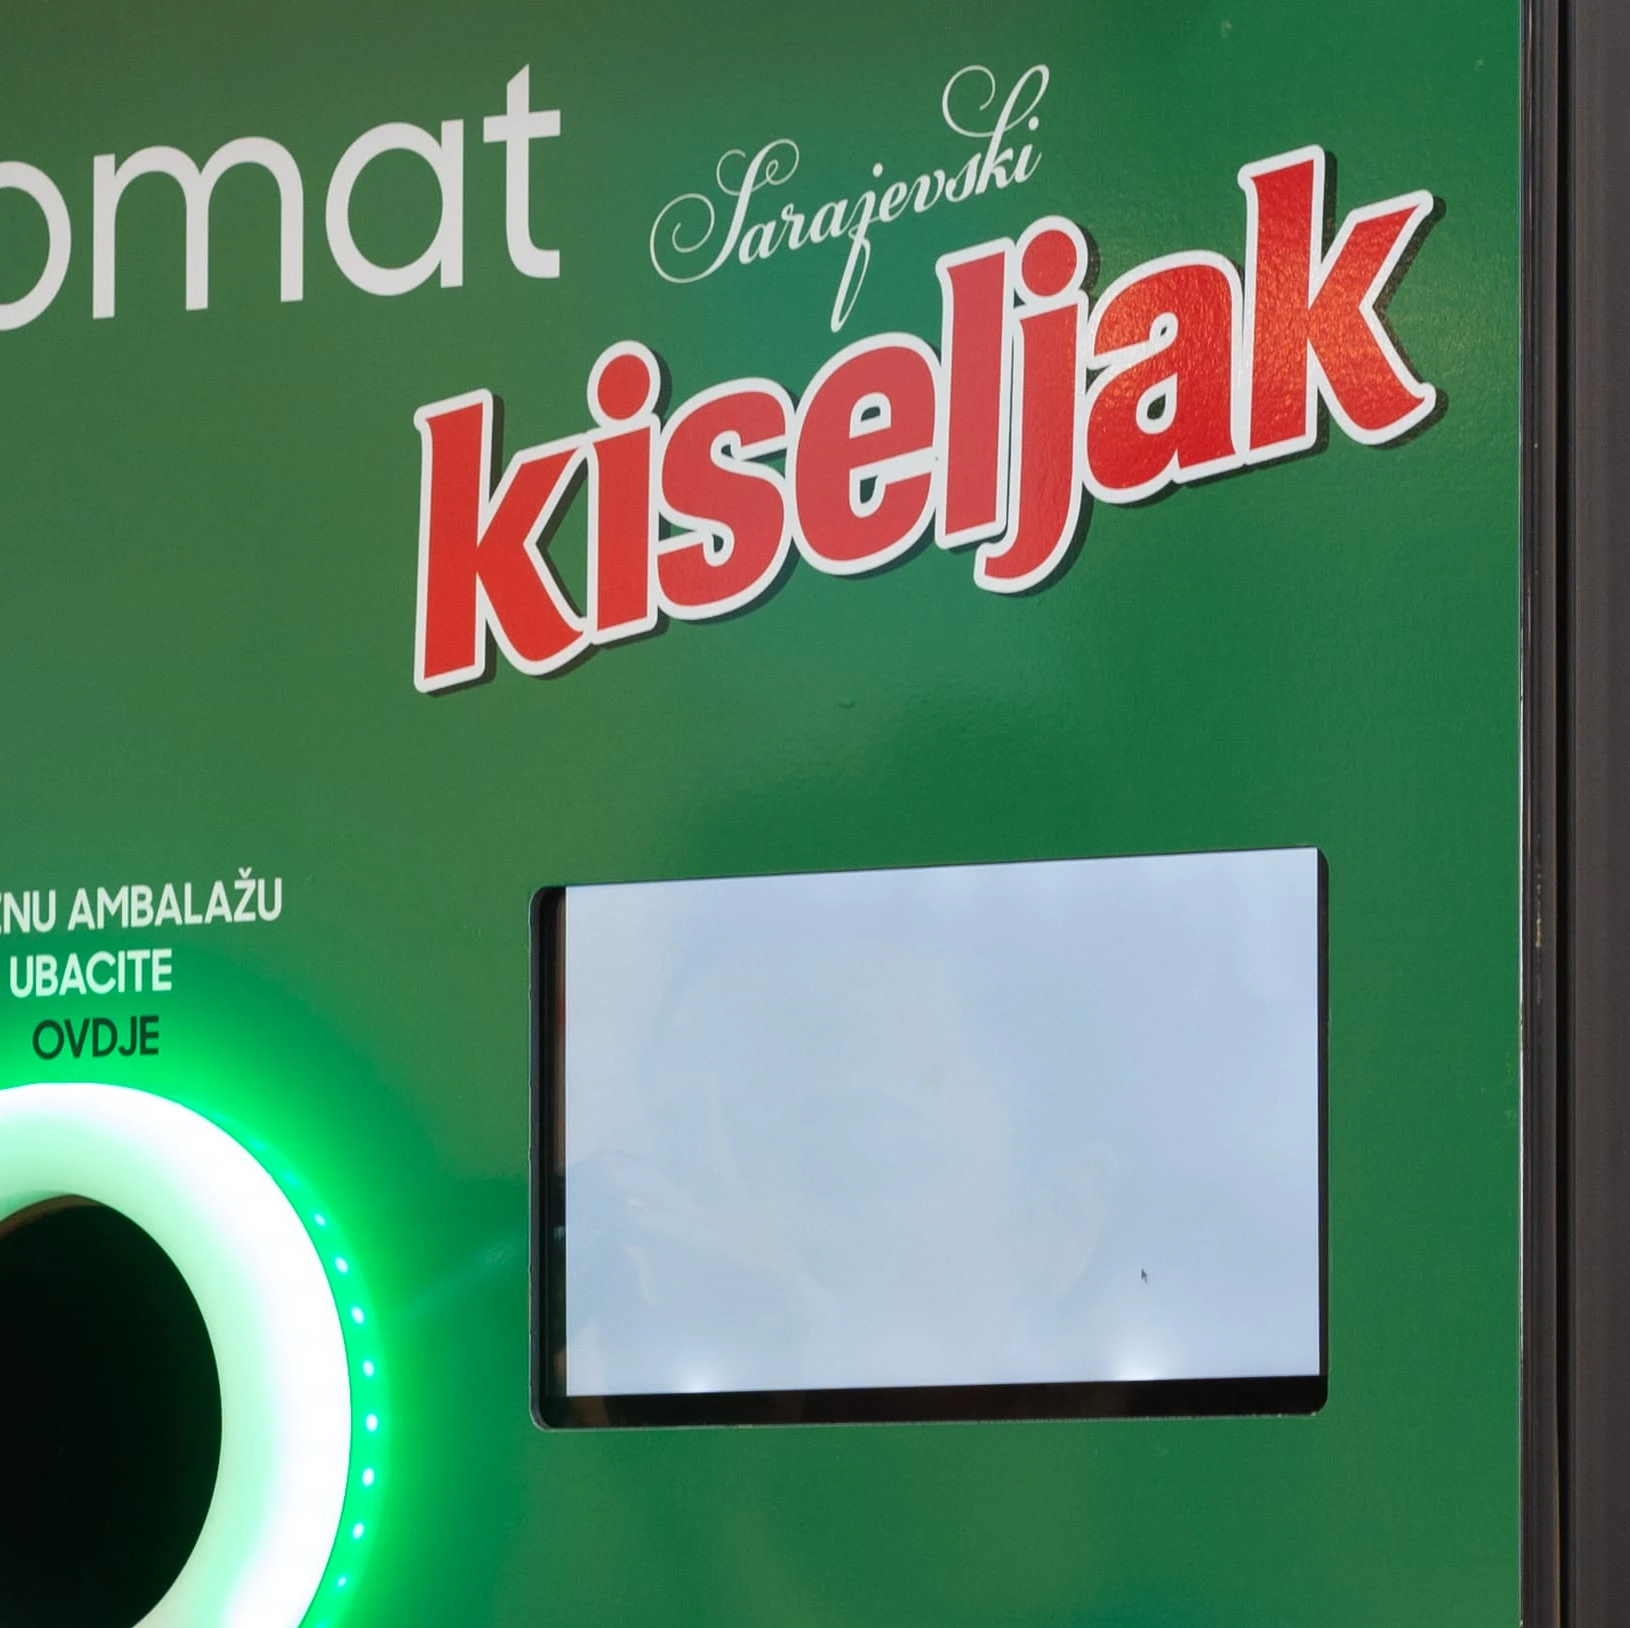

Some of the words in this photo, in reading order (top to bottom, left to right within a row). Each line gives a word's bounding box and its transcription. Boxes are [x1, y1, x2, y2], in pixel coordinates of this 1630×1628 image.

[650, 64, 1050, 331] Sarajevski
[415, 143, 1438, 693] kiseljak
[67, 867, 283, 931] AMBALAŽU
[10, 948, 172, 998] UBACITE
[32, 1015, 160, 1060] OVDJE
